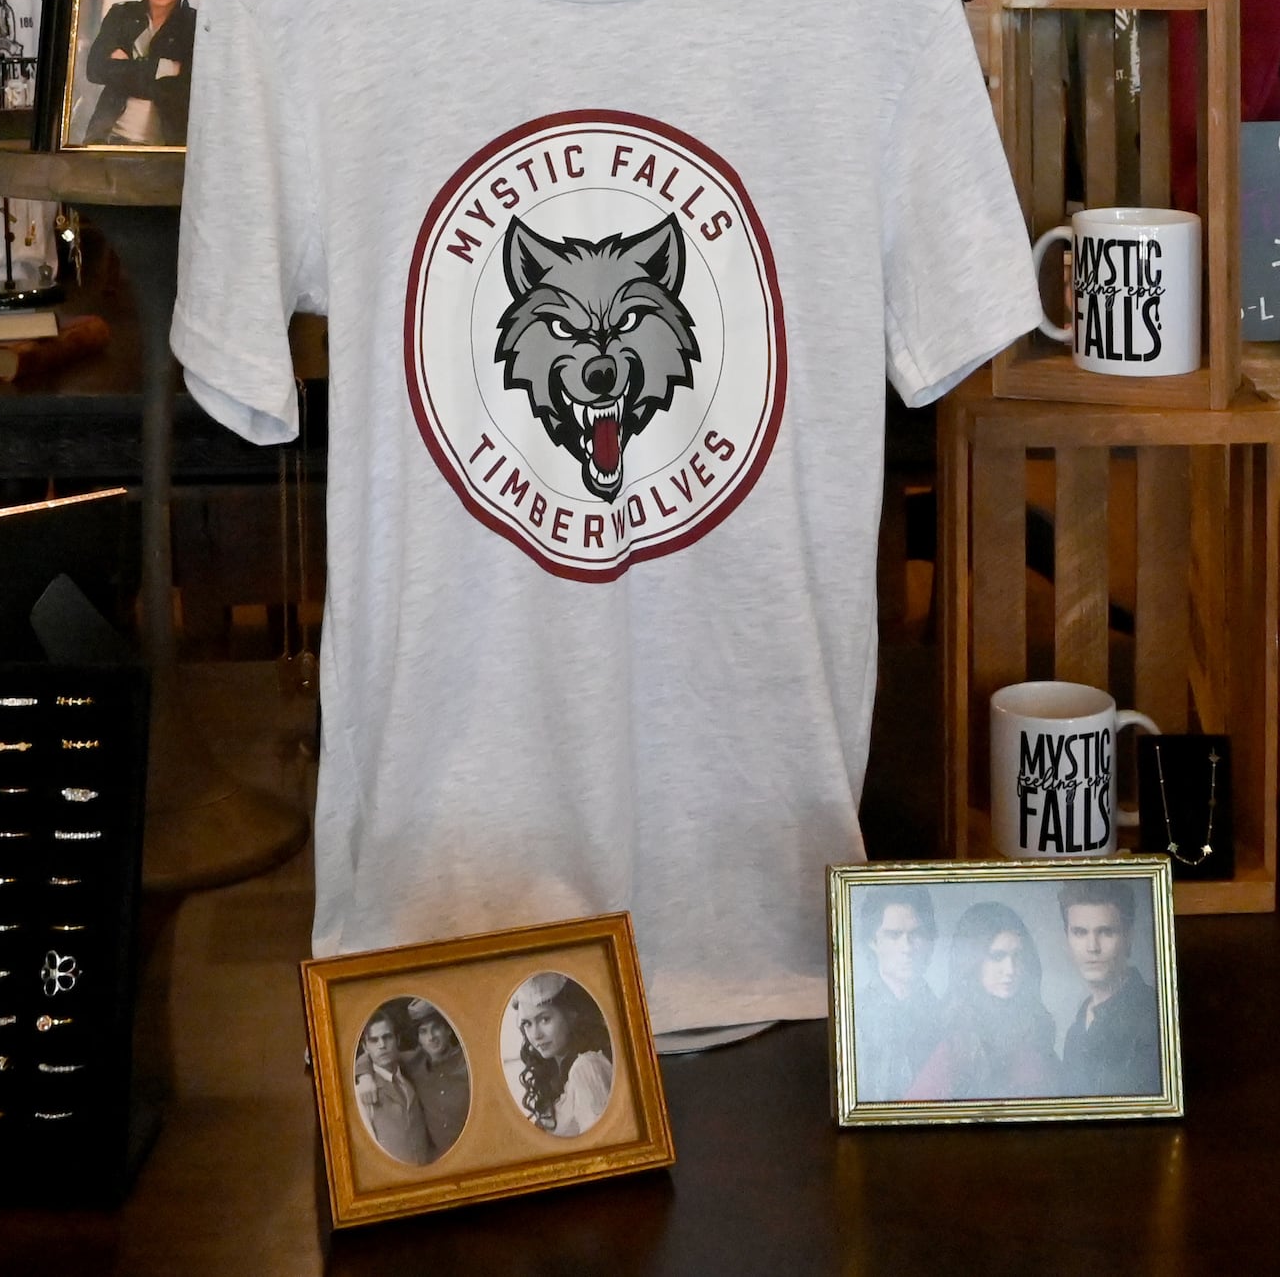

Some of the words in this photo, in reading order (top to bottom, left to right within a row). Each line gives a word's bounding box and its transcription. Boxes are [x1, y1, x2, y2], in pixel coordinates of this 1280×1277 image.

[446, 144, 586, 264] MYSTIC
[611, 145, 732, 242] FALLS
[1074, 234, 1162, 287] MYSTIC
[1074, 271, 1122, 311] eeling
[1074, 293, 1162, 362] FALLS
[468, 430, 736, 548] TIMBERWOLVES
[1020, 728, 1110, 779] MYSTIC
[1020, 785, 1110, 853] FALLS
